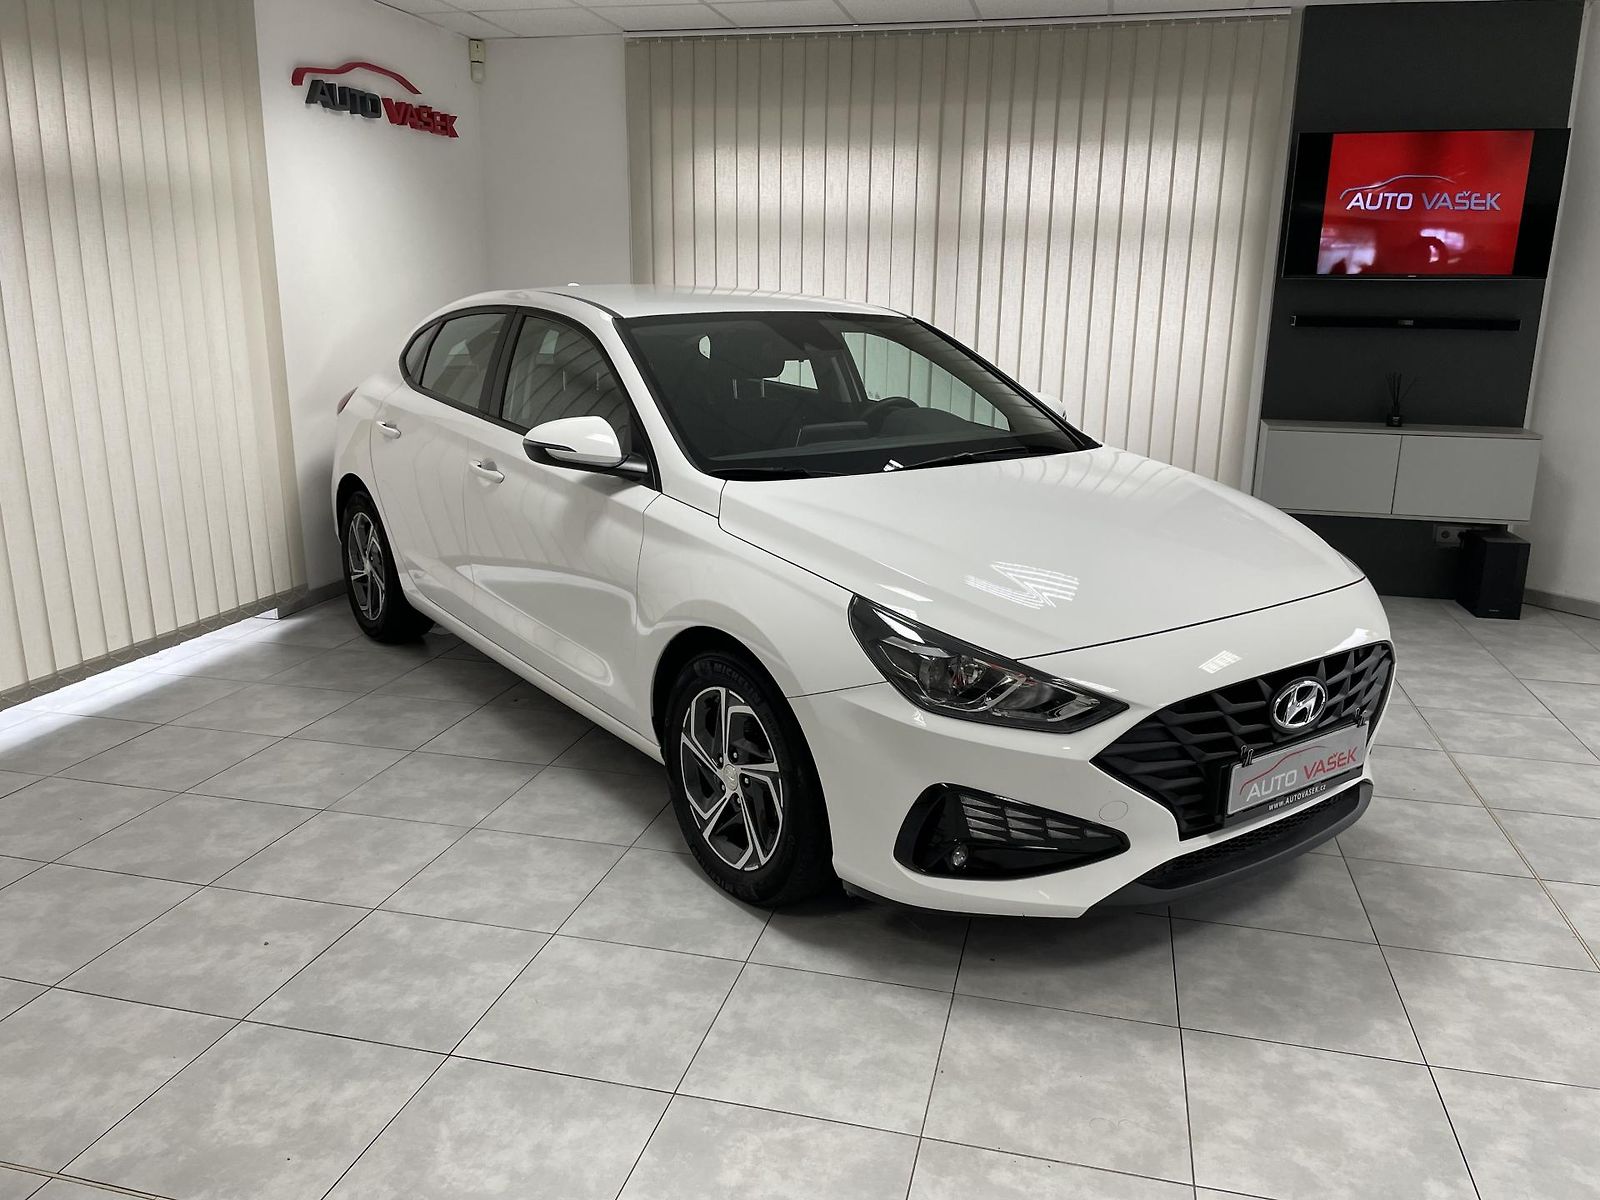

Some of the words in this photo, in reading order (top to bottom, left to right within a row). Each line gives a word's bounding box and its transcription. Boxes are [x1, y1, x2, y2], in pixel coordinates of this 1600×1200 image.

[305, 79, 382, 119] AUTO
[381, 97, 459, 138] VAŠEK
[1346, 192, 1413, 211] AUTO
[1421, 190, 1501, 211] VAŠEK
[1246, 769, 1298, 802] AUTO
[1303, 746, 1358, 780] VAŠEK
